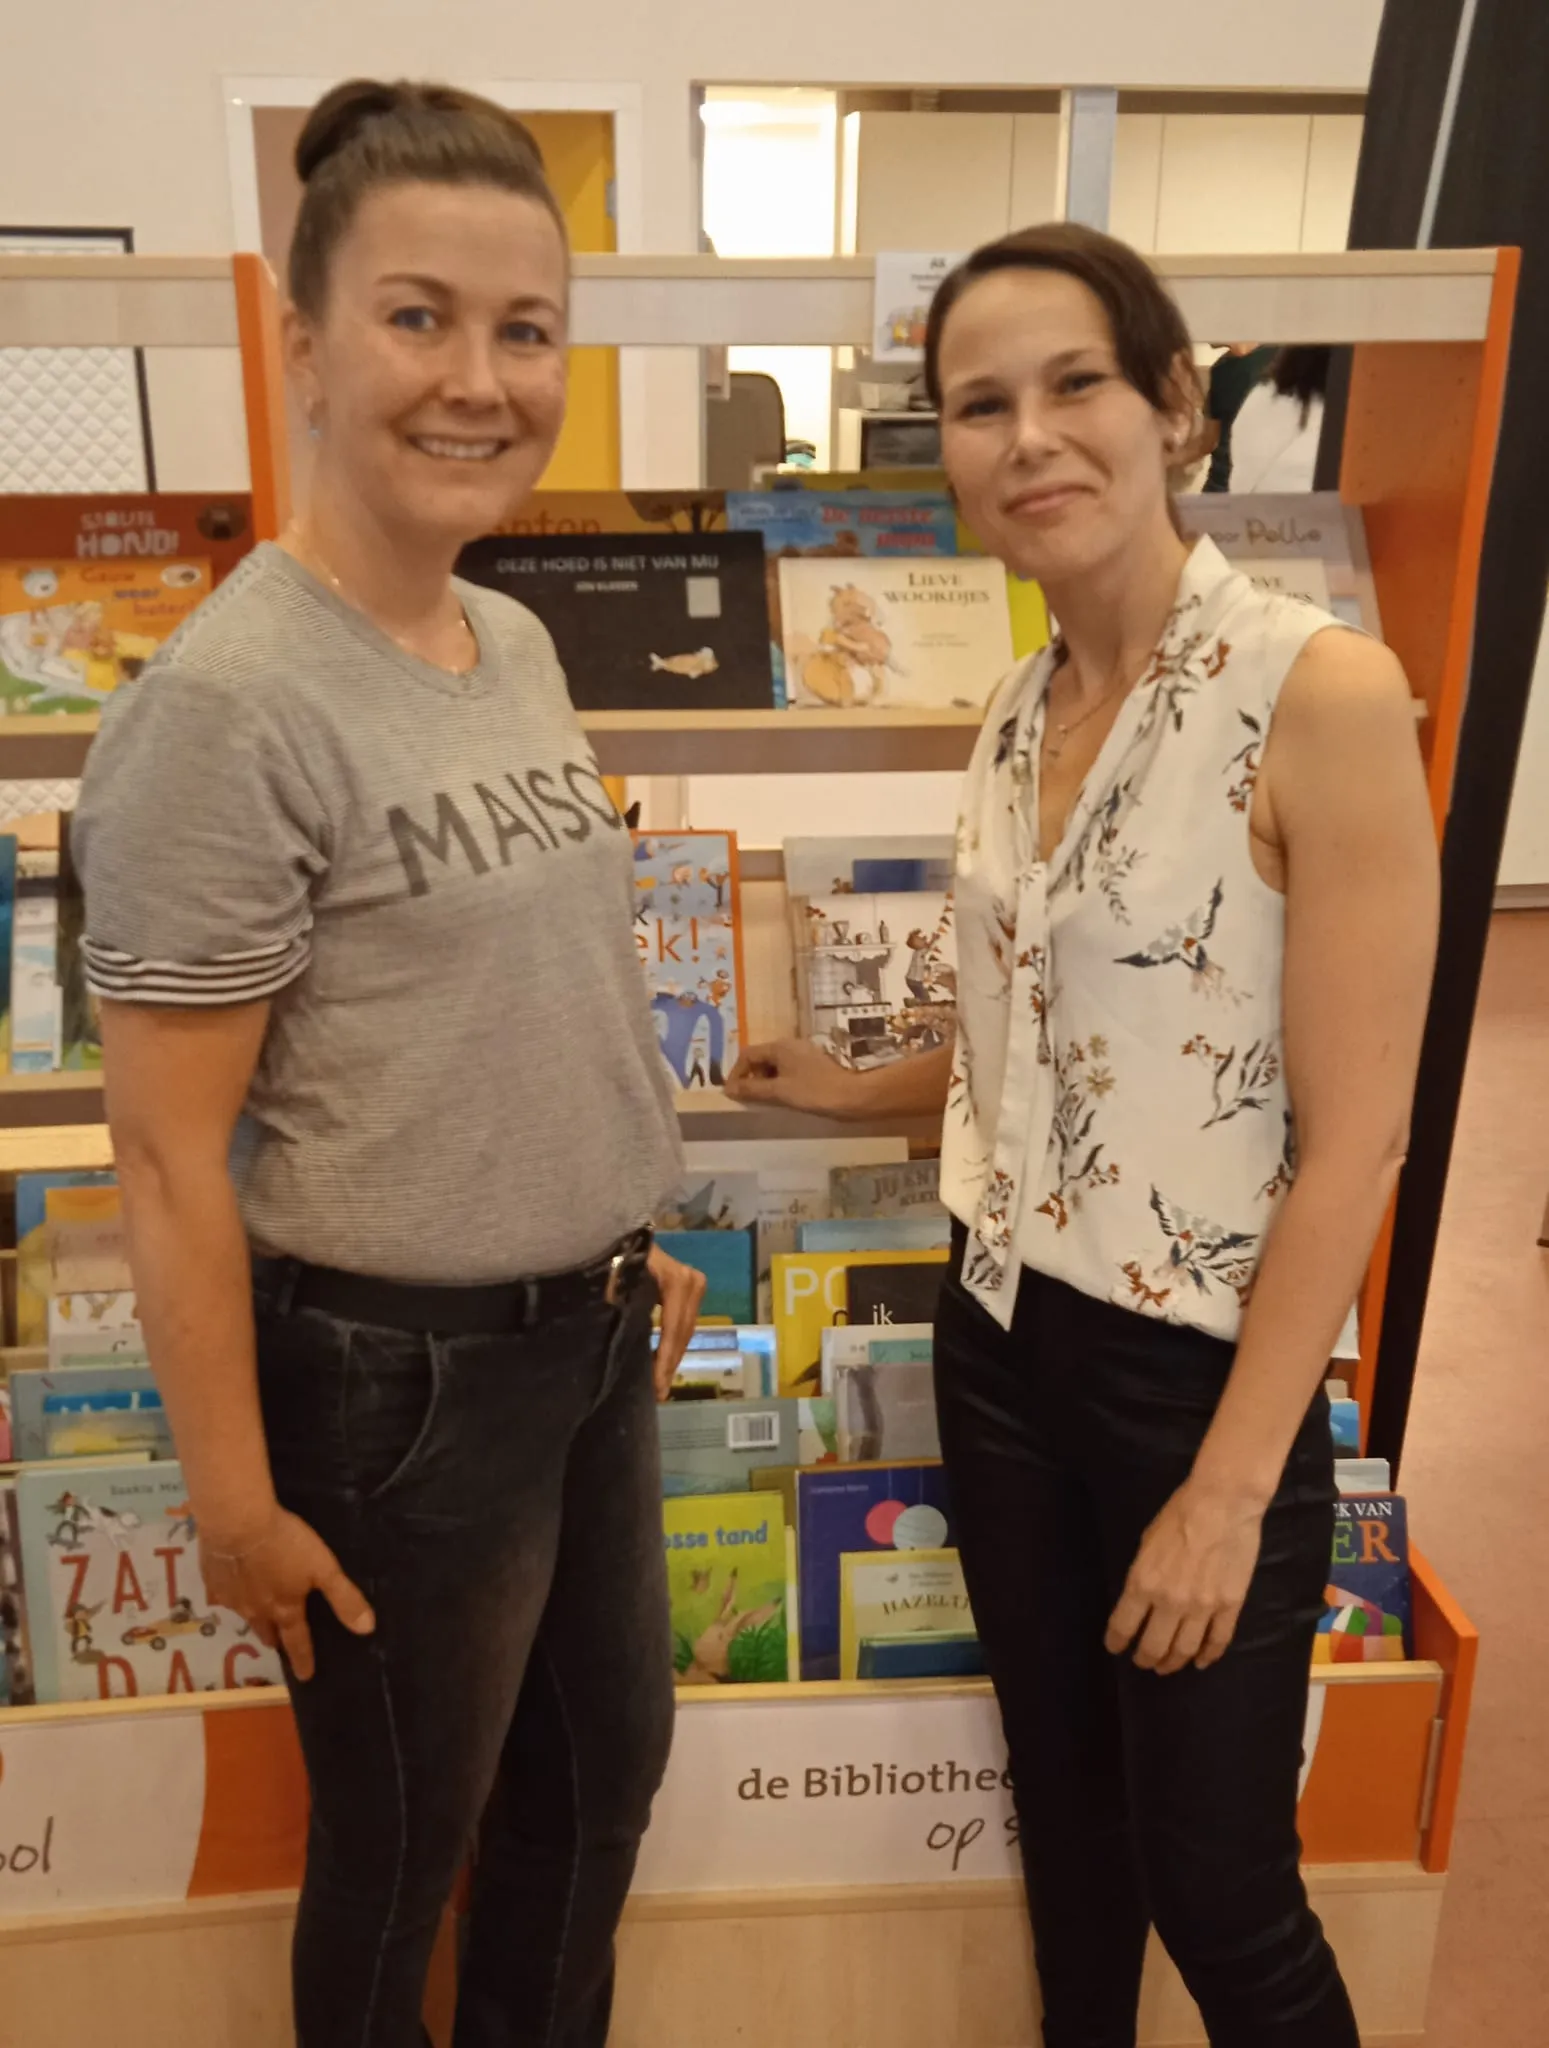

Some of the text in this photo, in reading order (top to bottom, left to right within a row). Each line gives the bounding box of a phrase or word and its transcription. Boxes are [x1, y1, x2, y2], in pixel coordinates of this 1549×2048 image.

[496, 557, 538, 574] DEZE
[542, 557, 590, 573] HOED
[611, 556, 646, 572] NIET
[651, 555, 687, 570] VAN
[908, 572, 961, 587] LIEVE
[386, 756, 624, 897] MAISO
[872, 1303, 894, 1325] ik
[1353, 1501, 1393, 1517] VAN
[715, 1520, 768, 1545] tand
[738, 1768, 789, 1801] de
[926, 1817, 986, 1871] op
